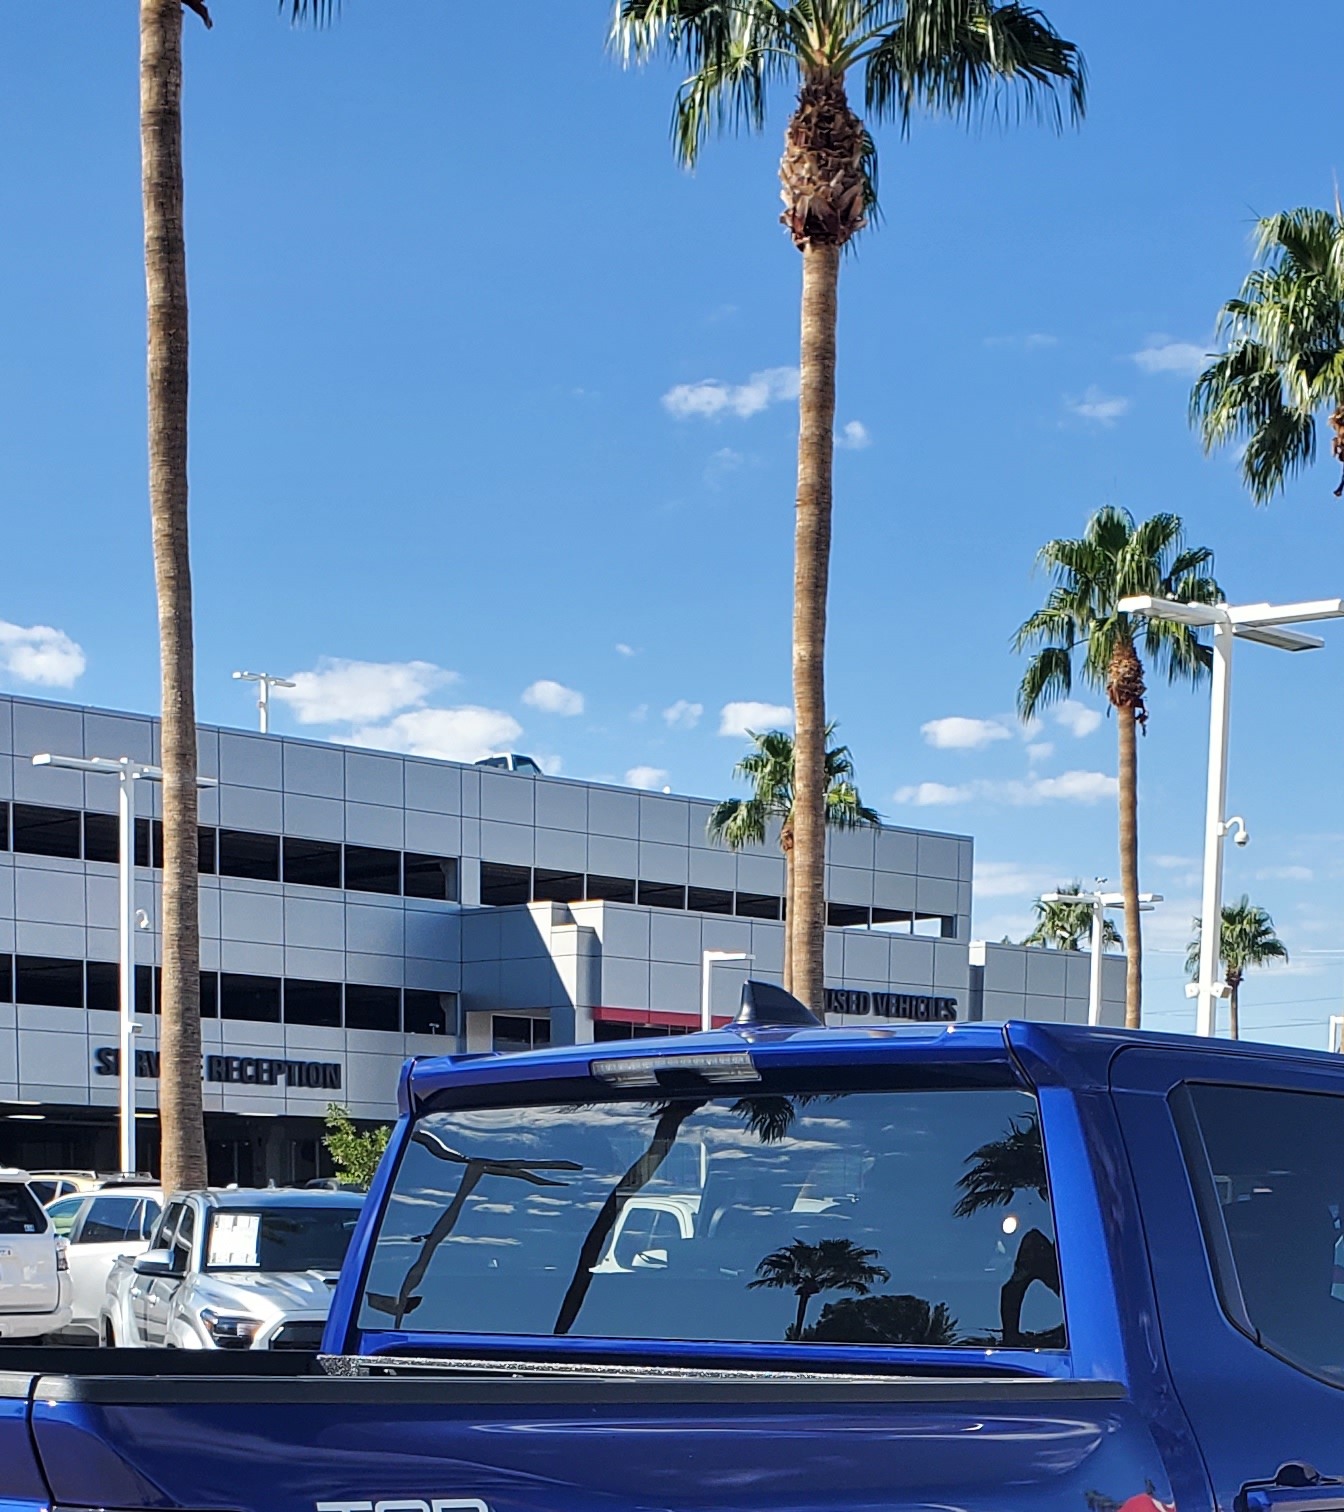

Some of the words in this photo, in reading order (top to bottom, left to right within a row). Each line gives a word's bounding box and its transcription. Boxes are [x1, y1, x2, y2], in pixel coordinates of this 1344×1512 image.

[823, 988, 870, 1015] USED
[871, 992, 958, 1022] VEHICLES
[208, 1055, 342, 1090] RECEPTION
